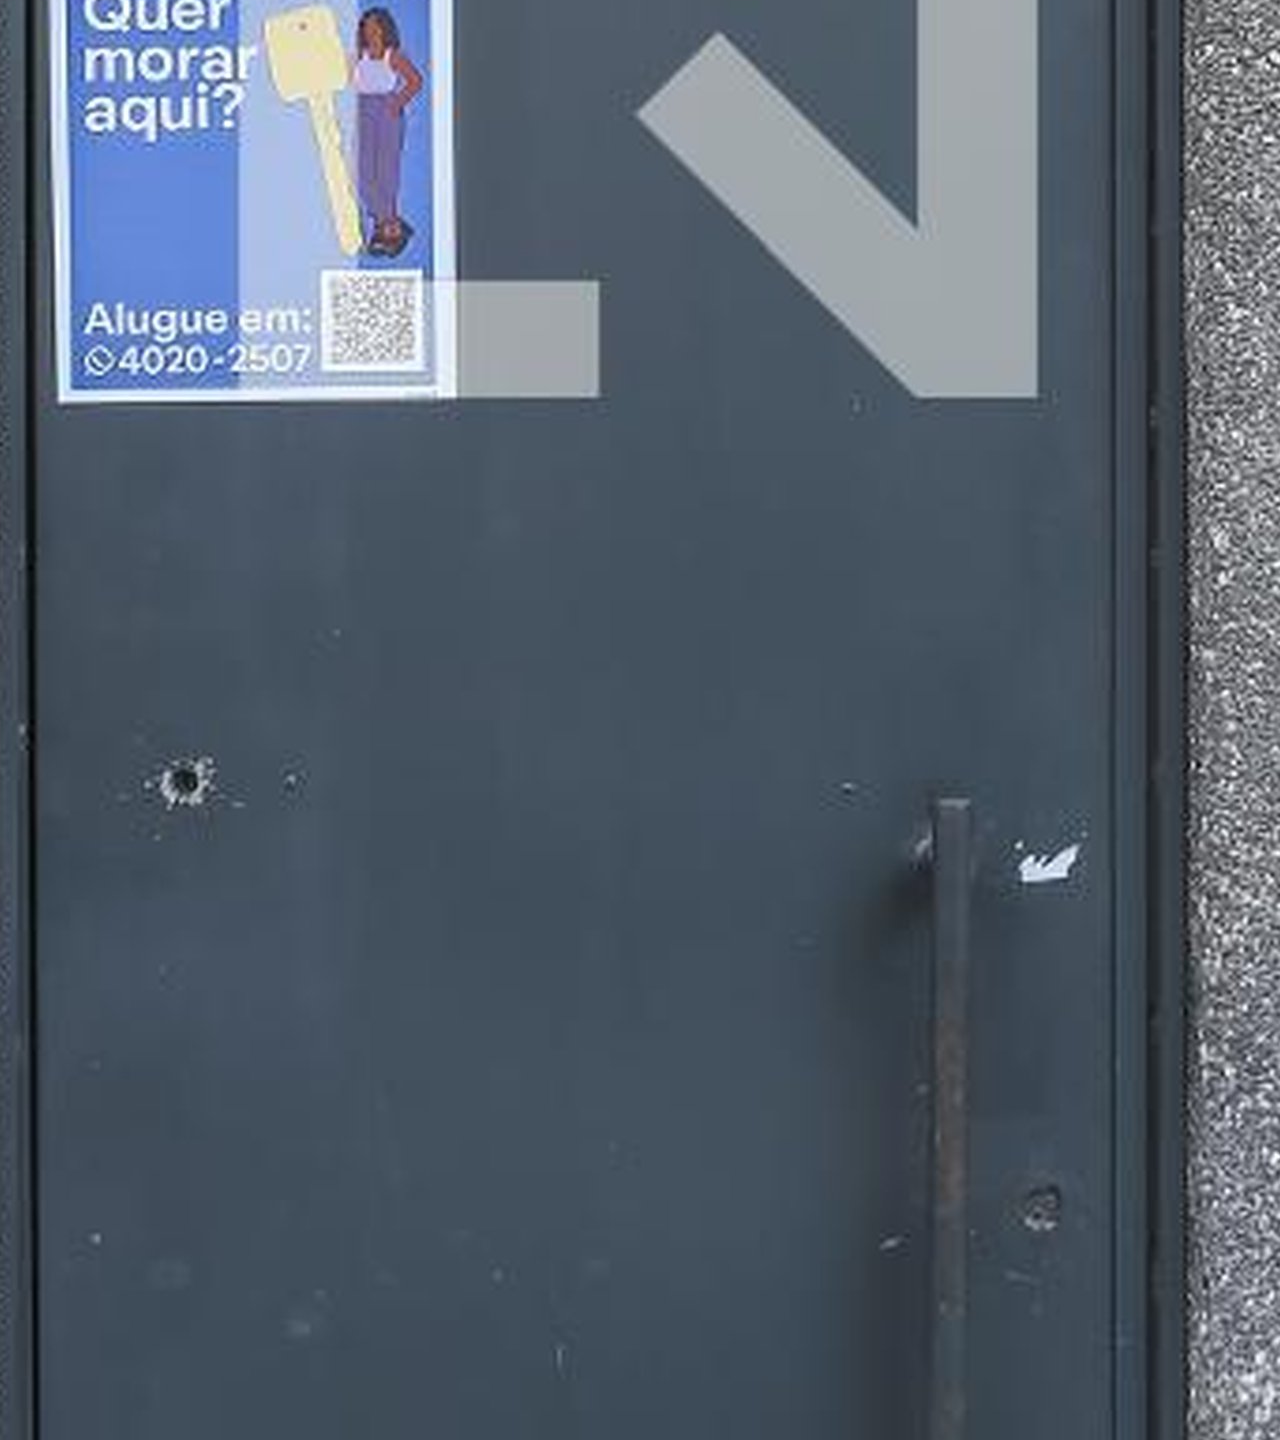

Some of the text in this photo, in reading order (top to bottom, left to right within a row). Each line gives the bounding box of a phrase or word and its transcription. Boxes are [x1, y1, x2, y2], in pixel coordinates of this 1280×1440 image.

[84, 45, 257, 82] morar
[84, 81, 246, 142] aqui?
[83, 302, 312, 344] Alugue em:
[118, 344, 312, 375] 4020-2507
